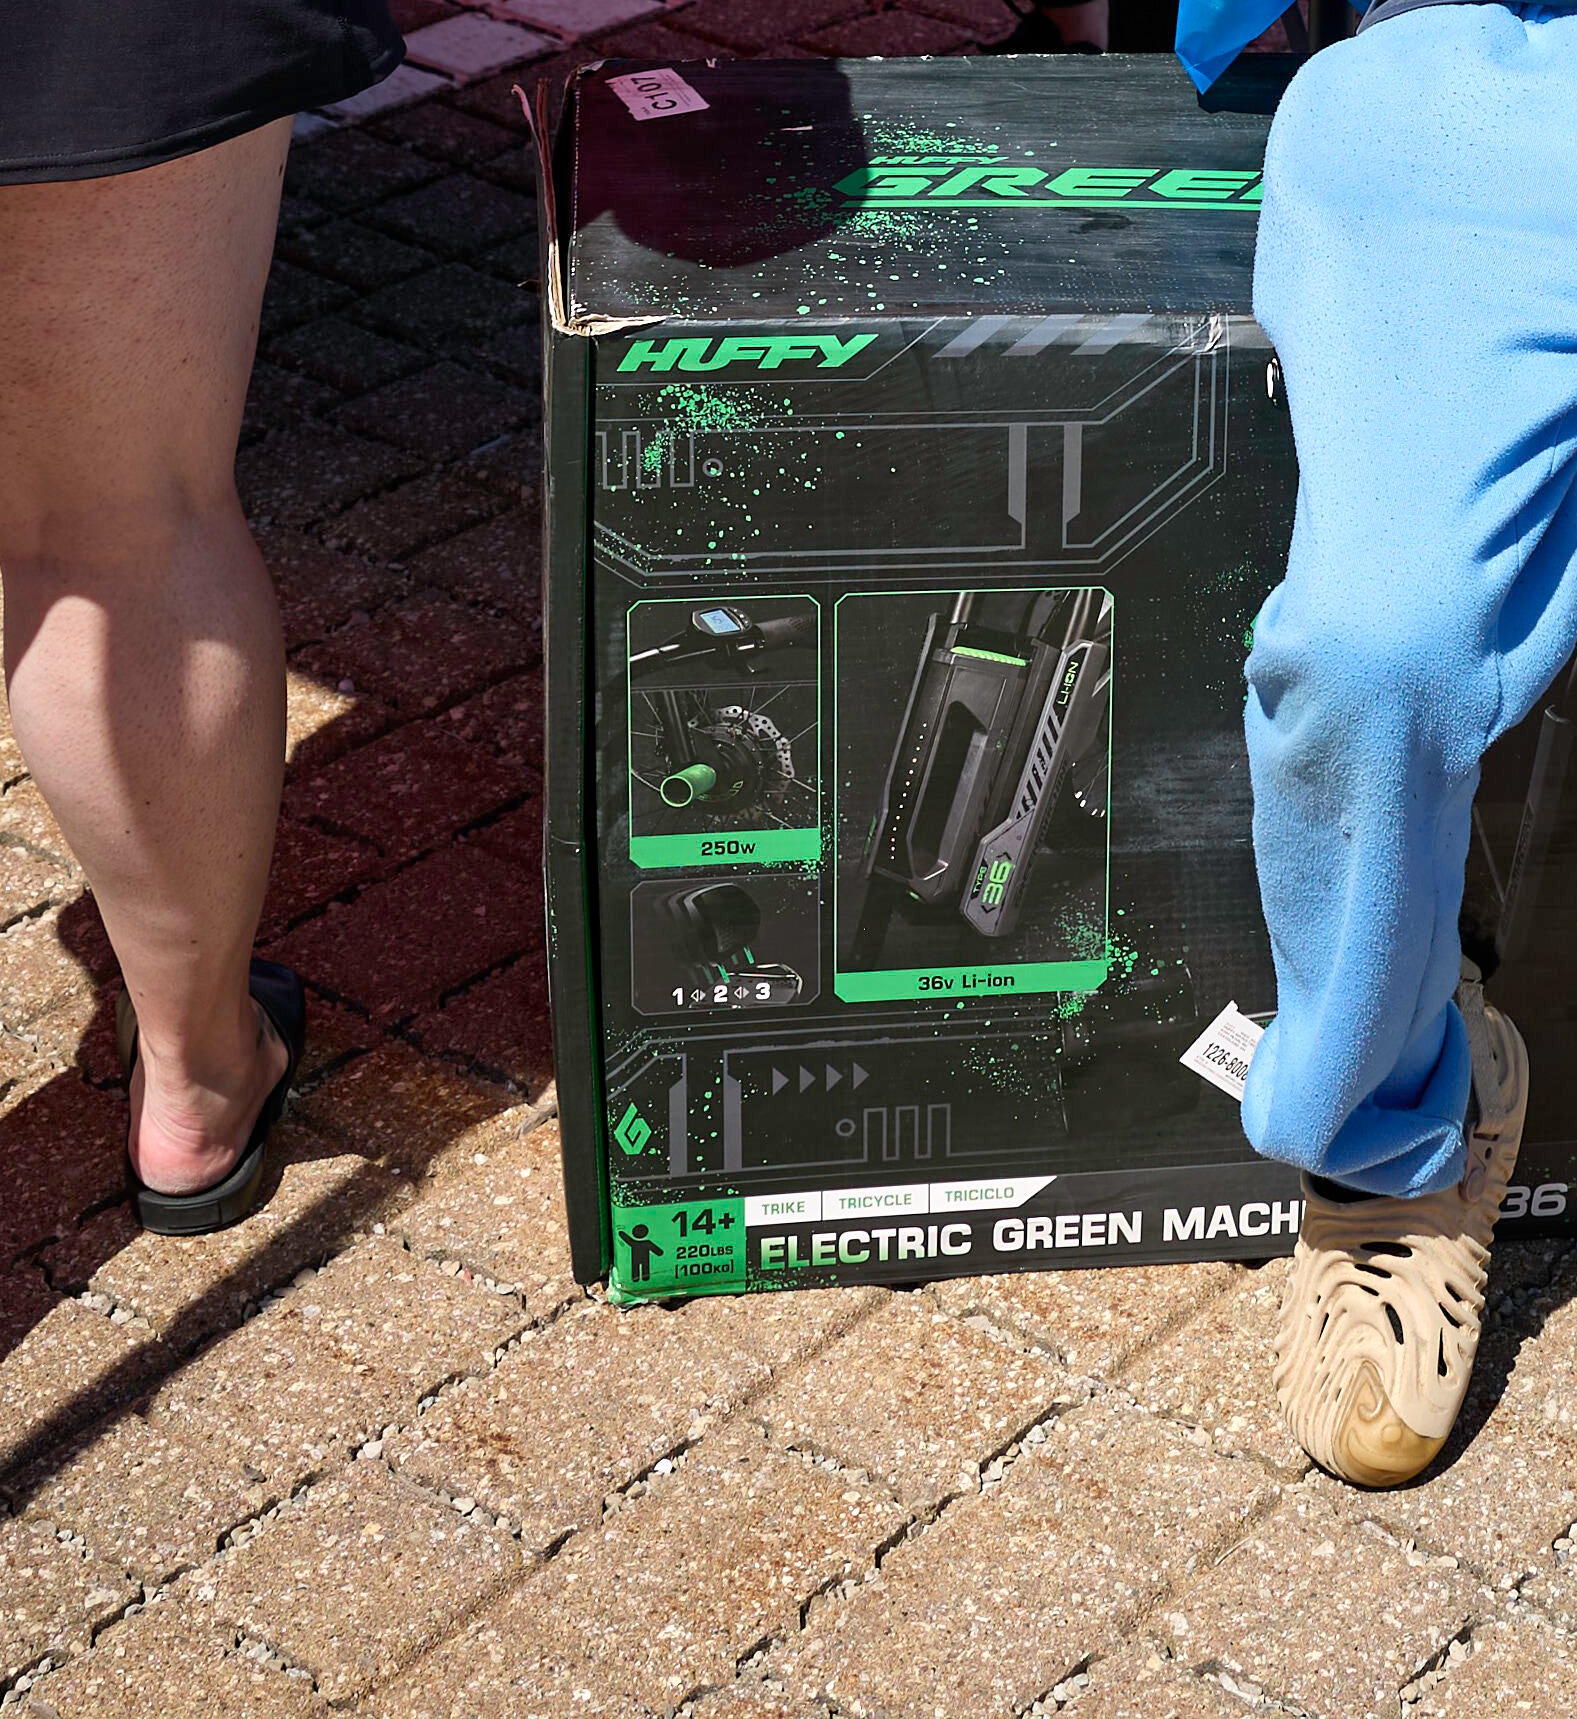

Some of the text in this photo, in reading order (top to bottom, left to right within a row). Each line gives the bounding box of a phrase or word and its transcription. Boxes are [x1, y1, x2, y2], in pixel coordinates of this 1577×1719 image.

[631, 77, 677, 110] C107
[868, 155, 1010, 165] HUFFY
[831, 166, 1262, 200] GREE
[615, 333, 880, 372] HUFFY
[1056, 661, 1079, 705] LI-ION
[701, 840, 756, 856] 250w
[982, 860, 1014, 905] 36
[671, 982, 772, 1006] 1 2 3
[918, 973, 1014, 992] 36v Li-ion
[761, 1186, 1015, 1216] TRIKE TRICYCLE TRICICLO
[1500, 1183, 1568, 1219] 36
[671, 1208, 736, 1238] 14+
[761, 1200, 1306, 1271] ELECTRIC GREEN MACH
[676, 1245, 733, 1260] 220LBS
